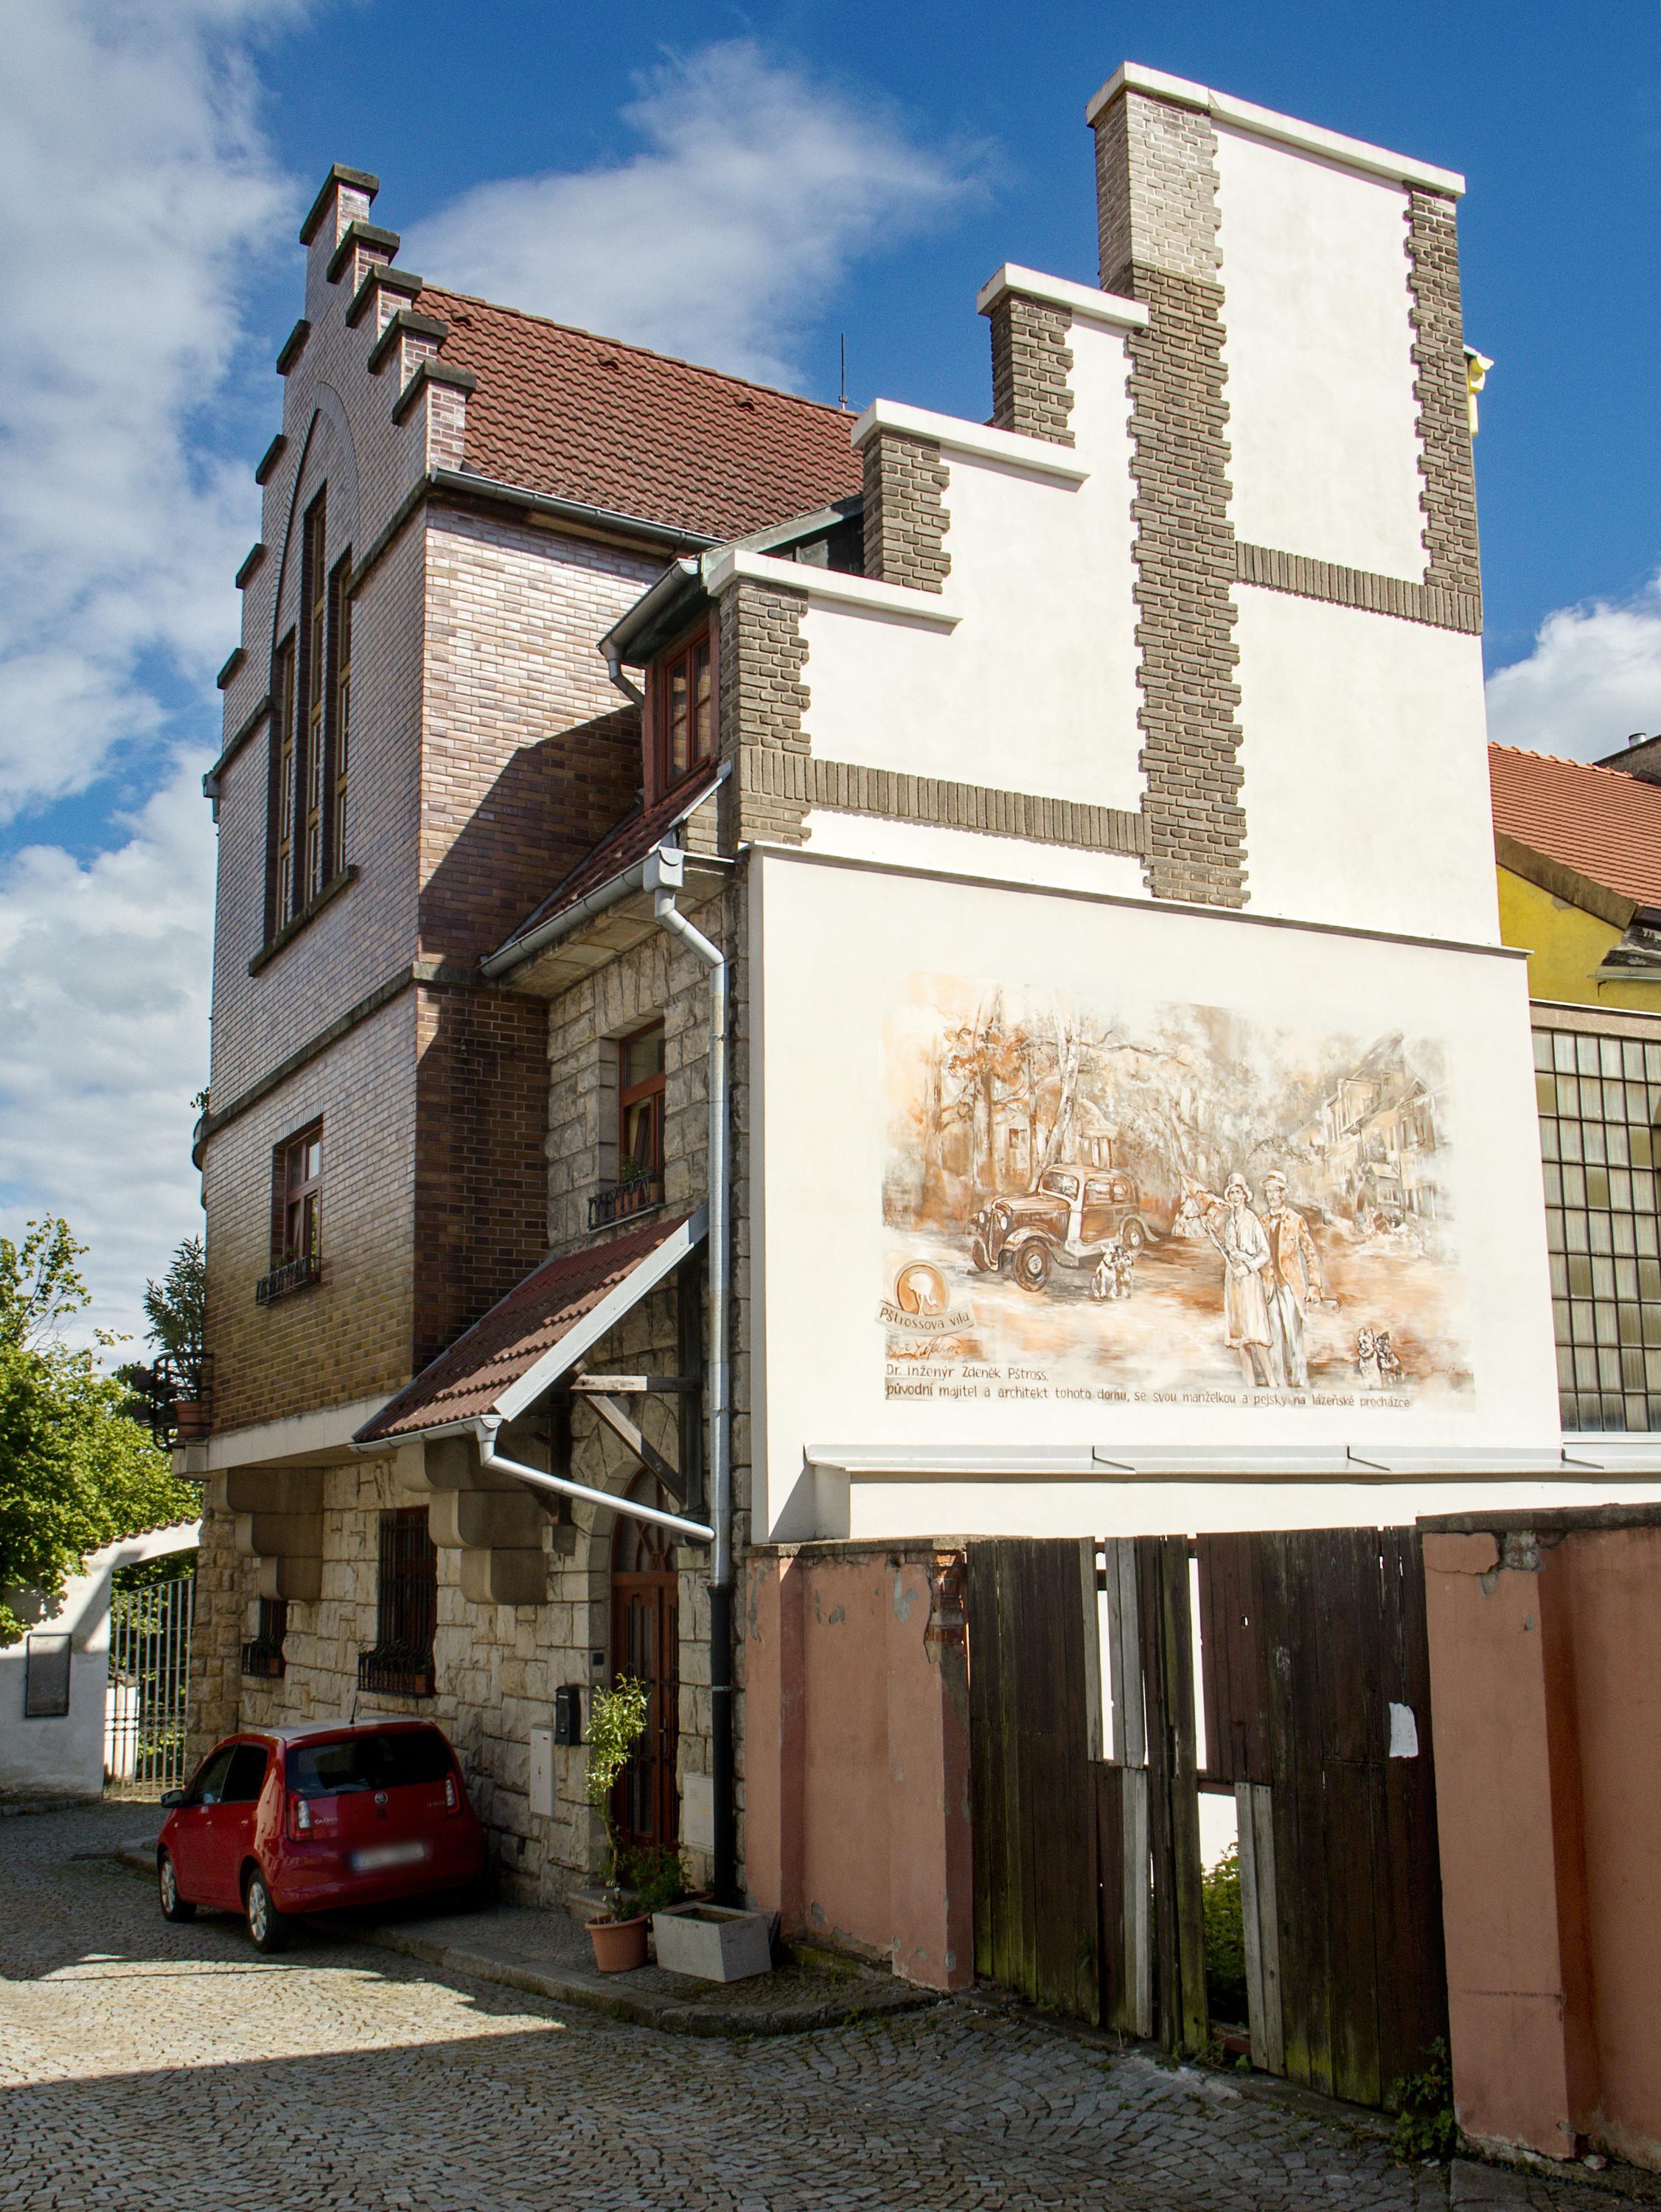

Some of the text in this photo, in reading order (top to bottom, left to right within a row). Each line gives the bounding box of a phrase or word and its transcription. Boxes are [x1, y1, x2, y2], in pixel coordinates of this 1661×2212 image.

[880, 1307, 969, 1329] Pštrossova vila
[887, 1364, 901, 1376] Dr.
[962, 1366, 1001, 1379] Zdeněk
[886, 1382, 933, 1398] původní
[939, 1385, 977, 1398] majitel
[984, 1387, 991, 1398] a
[998, 1385, 1049, 1399] architekt
[1056, 1388, 1091, 1399] tohoto
[1134, 1391, 1146, 1401] se
[1153, 1392, 1177, 1402] svou
[1183, 1391, 1236, 1404] manželkou
[1242, 1394, 1248, 1403] a
[1254, 1393, 1287, 1408] pejsky
[1294, 1397, 1306, 1405] na
[1312, 1394, 1354, 1407] lázeňské
[1360, 1395, 1410, 1409] procházce
